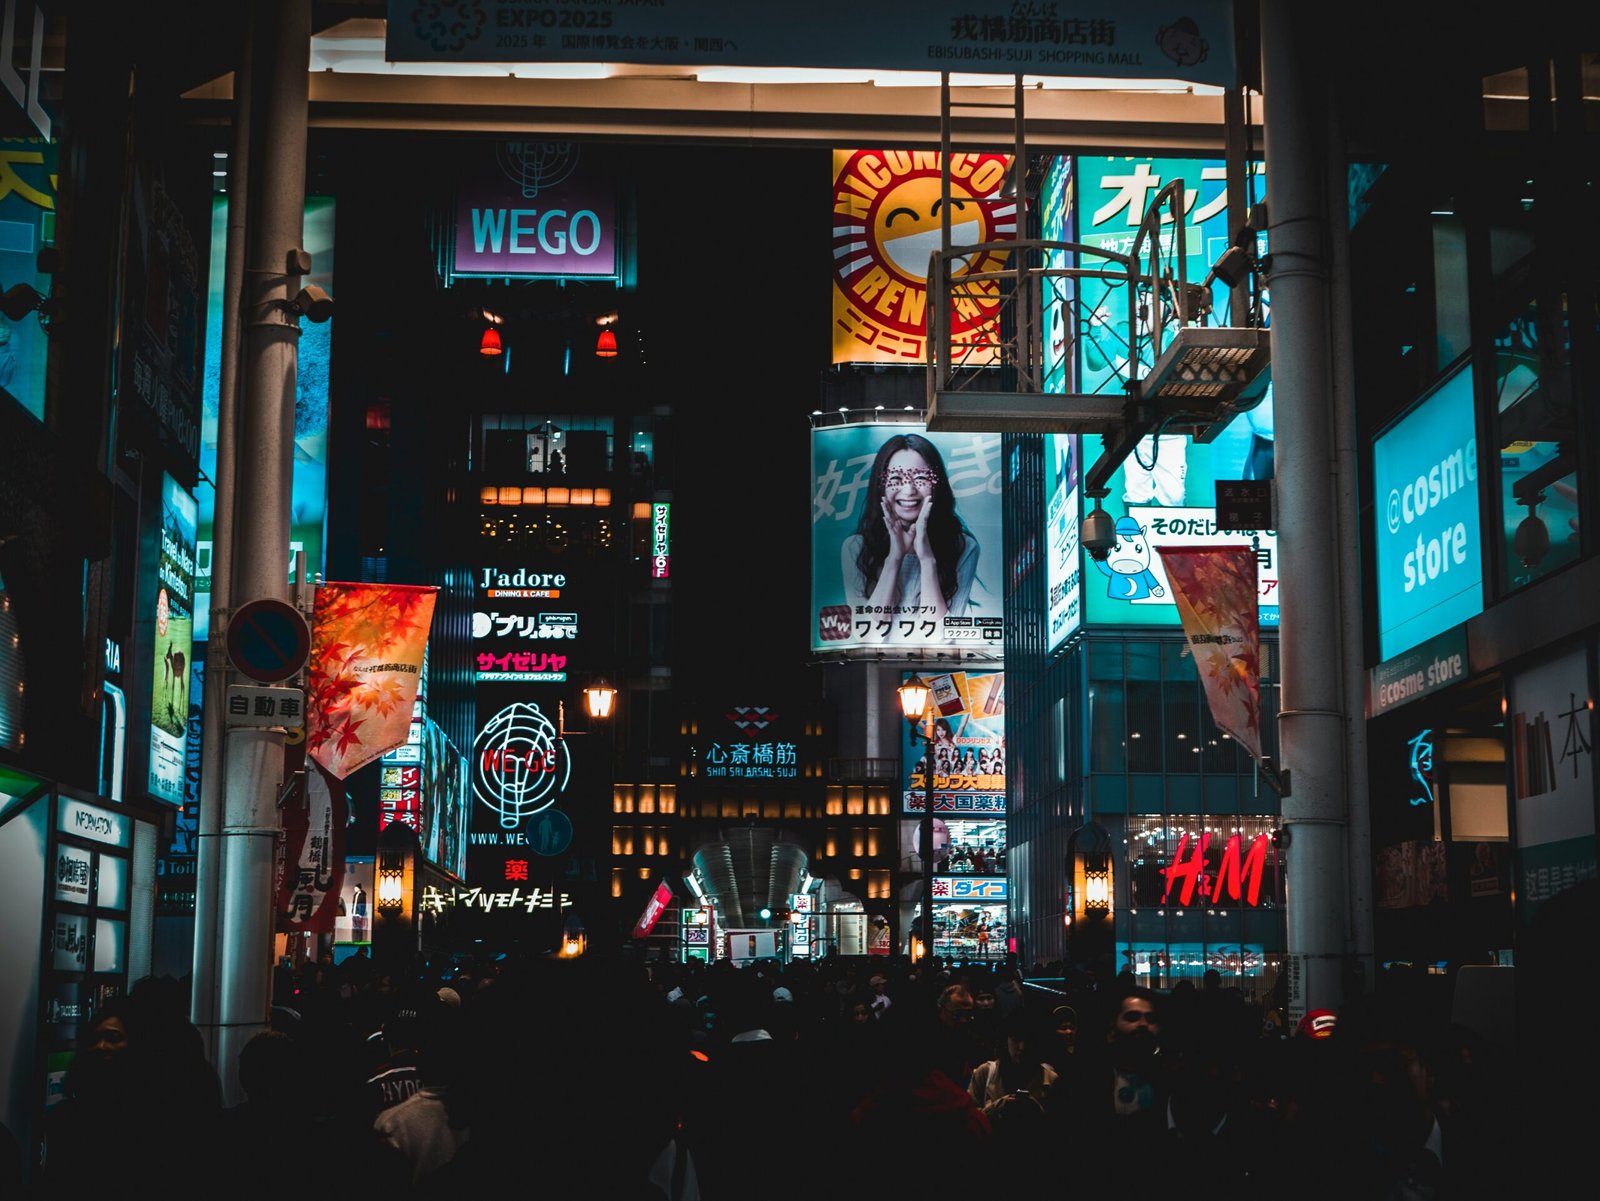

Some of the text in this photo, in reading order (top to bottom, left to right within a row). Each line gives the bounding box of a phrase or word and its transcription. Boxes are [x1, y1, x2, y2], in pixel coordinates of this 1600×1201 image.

[496, 35, 528, 48] 2025
[532, 35, 546, 48] 年
[951, 15, 1117, 46] 戎橋筋商店街
[928, 46, 1143, 66] EBISUBASHI-SUJI SHOPPING MALL
[471, 208, 602, 256] WEGO
[1387, 437, 1478, 534] @cosme
[656, 507, 667, 553] サイゼリヤ
[656, 556, 667, 578] 6F
[1403, 521, 1467, 593] store
[480, 567, 566, 589] J'adore
[495, 590, 521, 598] DINING
[530, 590, 551, 598] CAFE
[855, 605, 937, 615] 運命の出会いアプリ
[855, 619, 937, 639] ワクワク
[947, 629, 977, 637] ワクワク
[476, 651, 568, 672] サイゼリヤ
[1379, 670, 1425, 707] @cosme
[1427, 653, 1462, 688] store
[229, 695, 300, 718] 自動車
[706, 742, 797, 765] 心斎橋筋
[706, 767, 727, 777] SHIN
[729, 767, 744, 777] SAI
[383, 801, 396, 828] コミ
[505, 859, 528, 881] 薬
[1159, 832, 1269, 907] H&M
[932, 879, 950, 896] 薬
[460, 887, 573, 913] マツモトキヨシ
